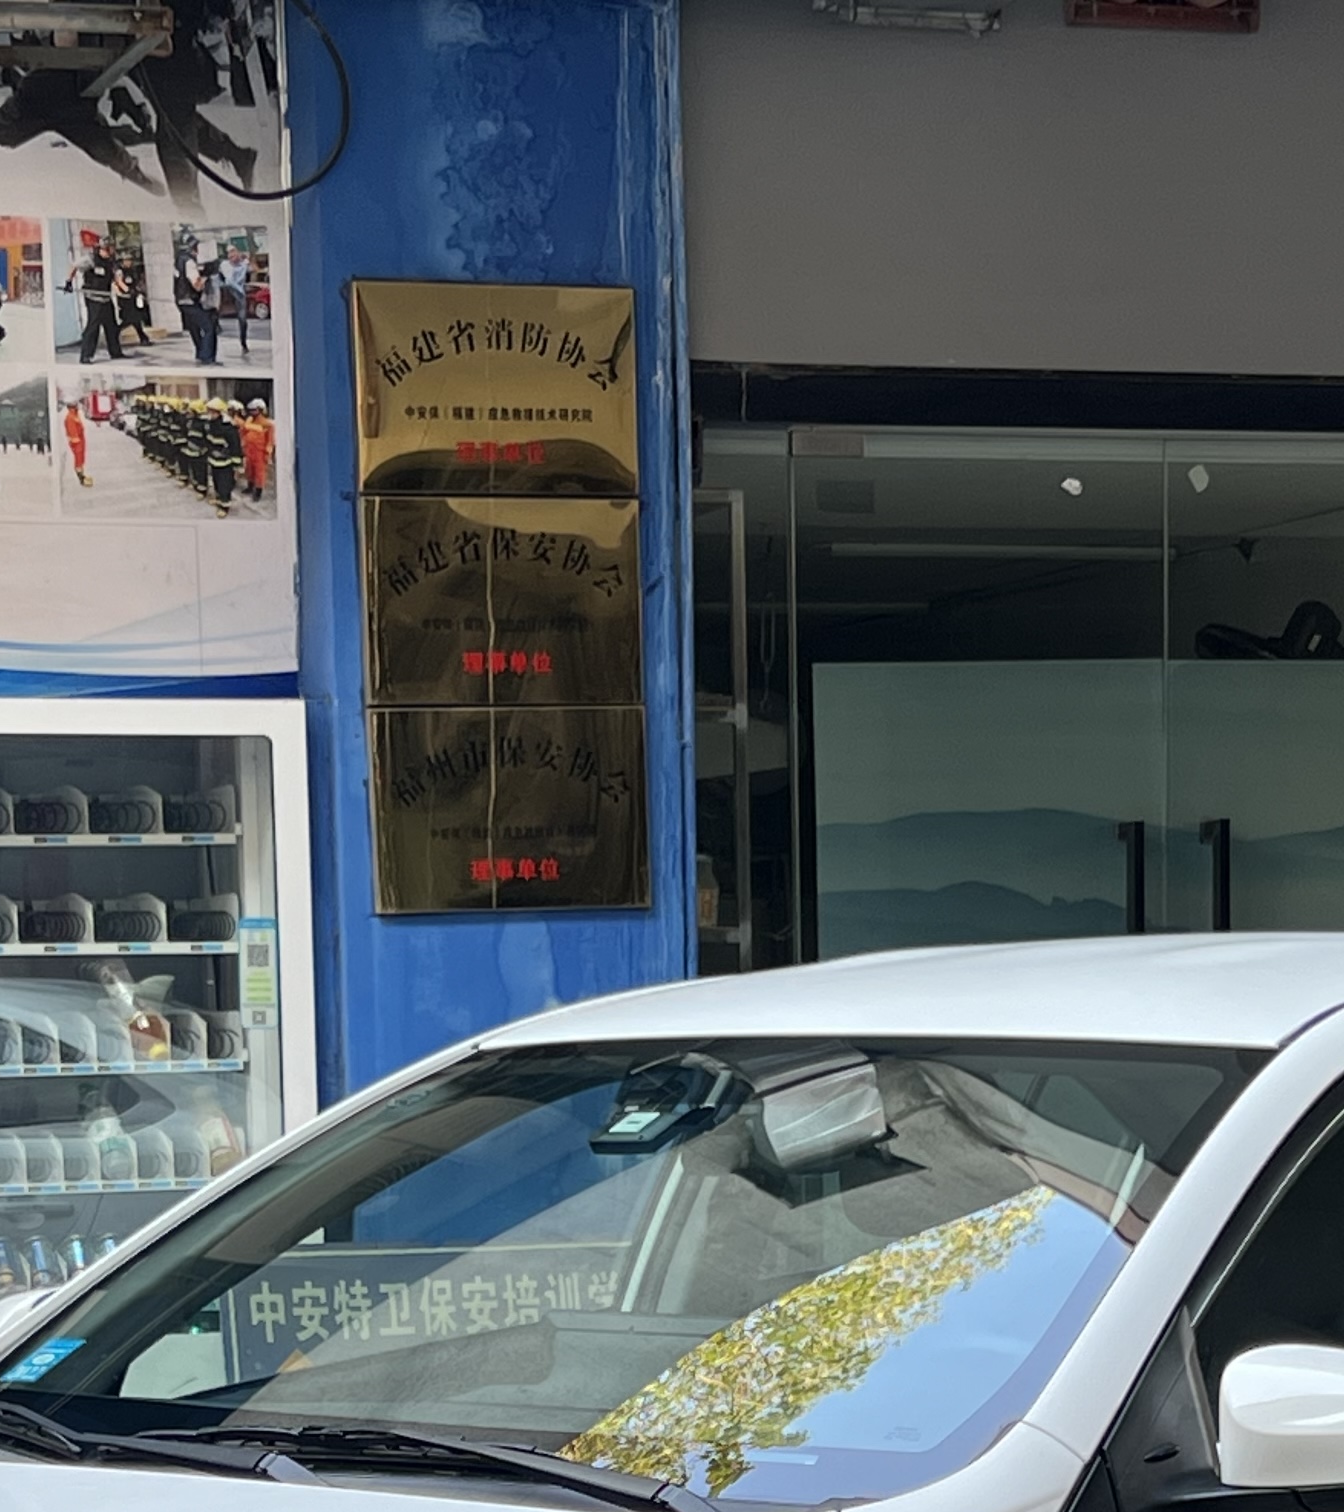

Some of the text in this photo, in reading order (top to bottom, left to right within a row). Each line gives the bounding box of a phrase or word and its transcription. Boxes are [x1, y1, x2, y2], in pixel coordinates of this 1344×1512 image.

[375, 317, 619, 392] 福建省消防协会
[384, 526, 624, 597] 福建省保安协会
